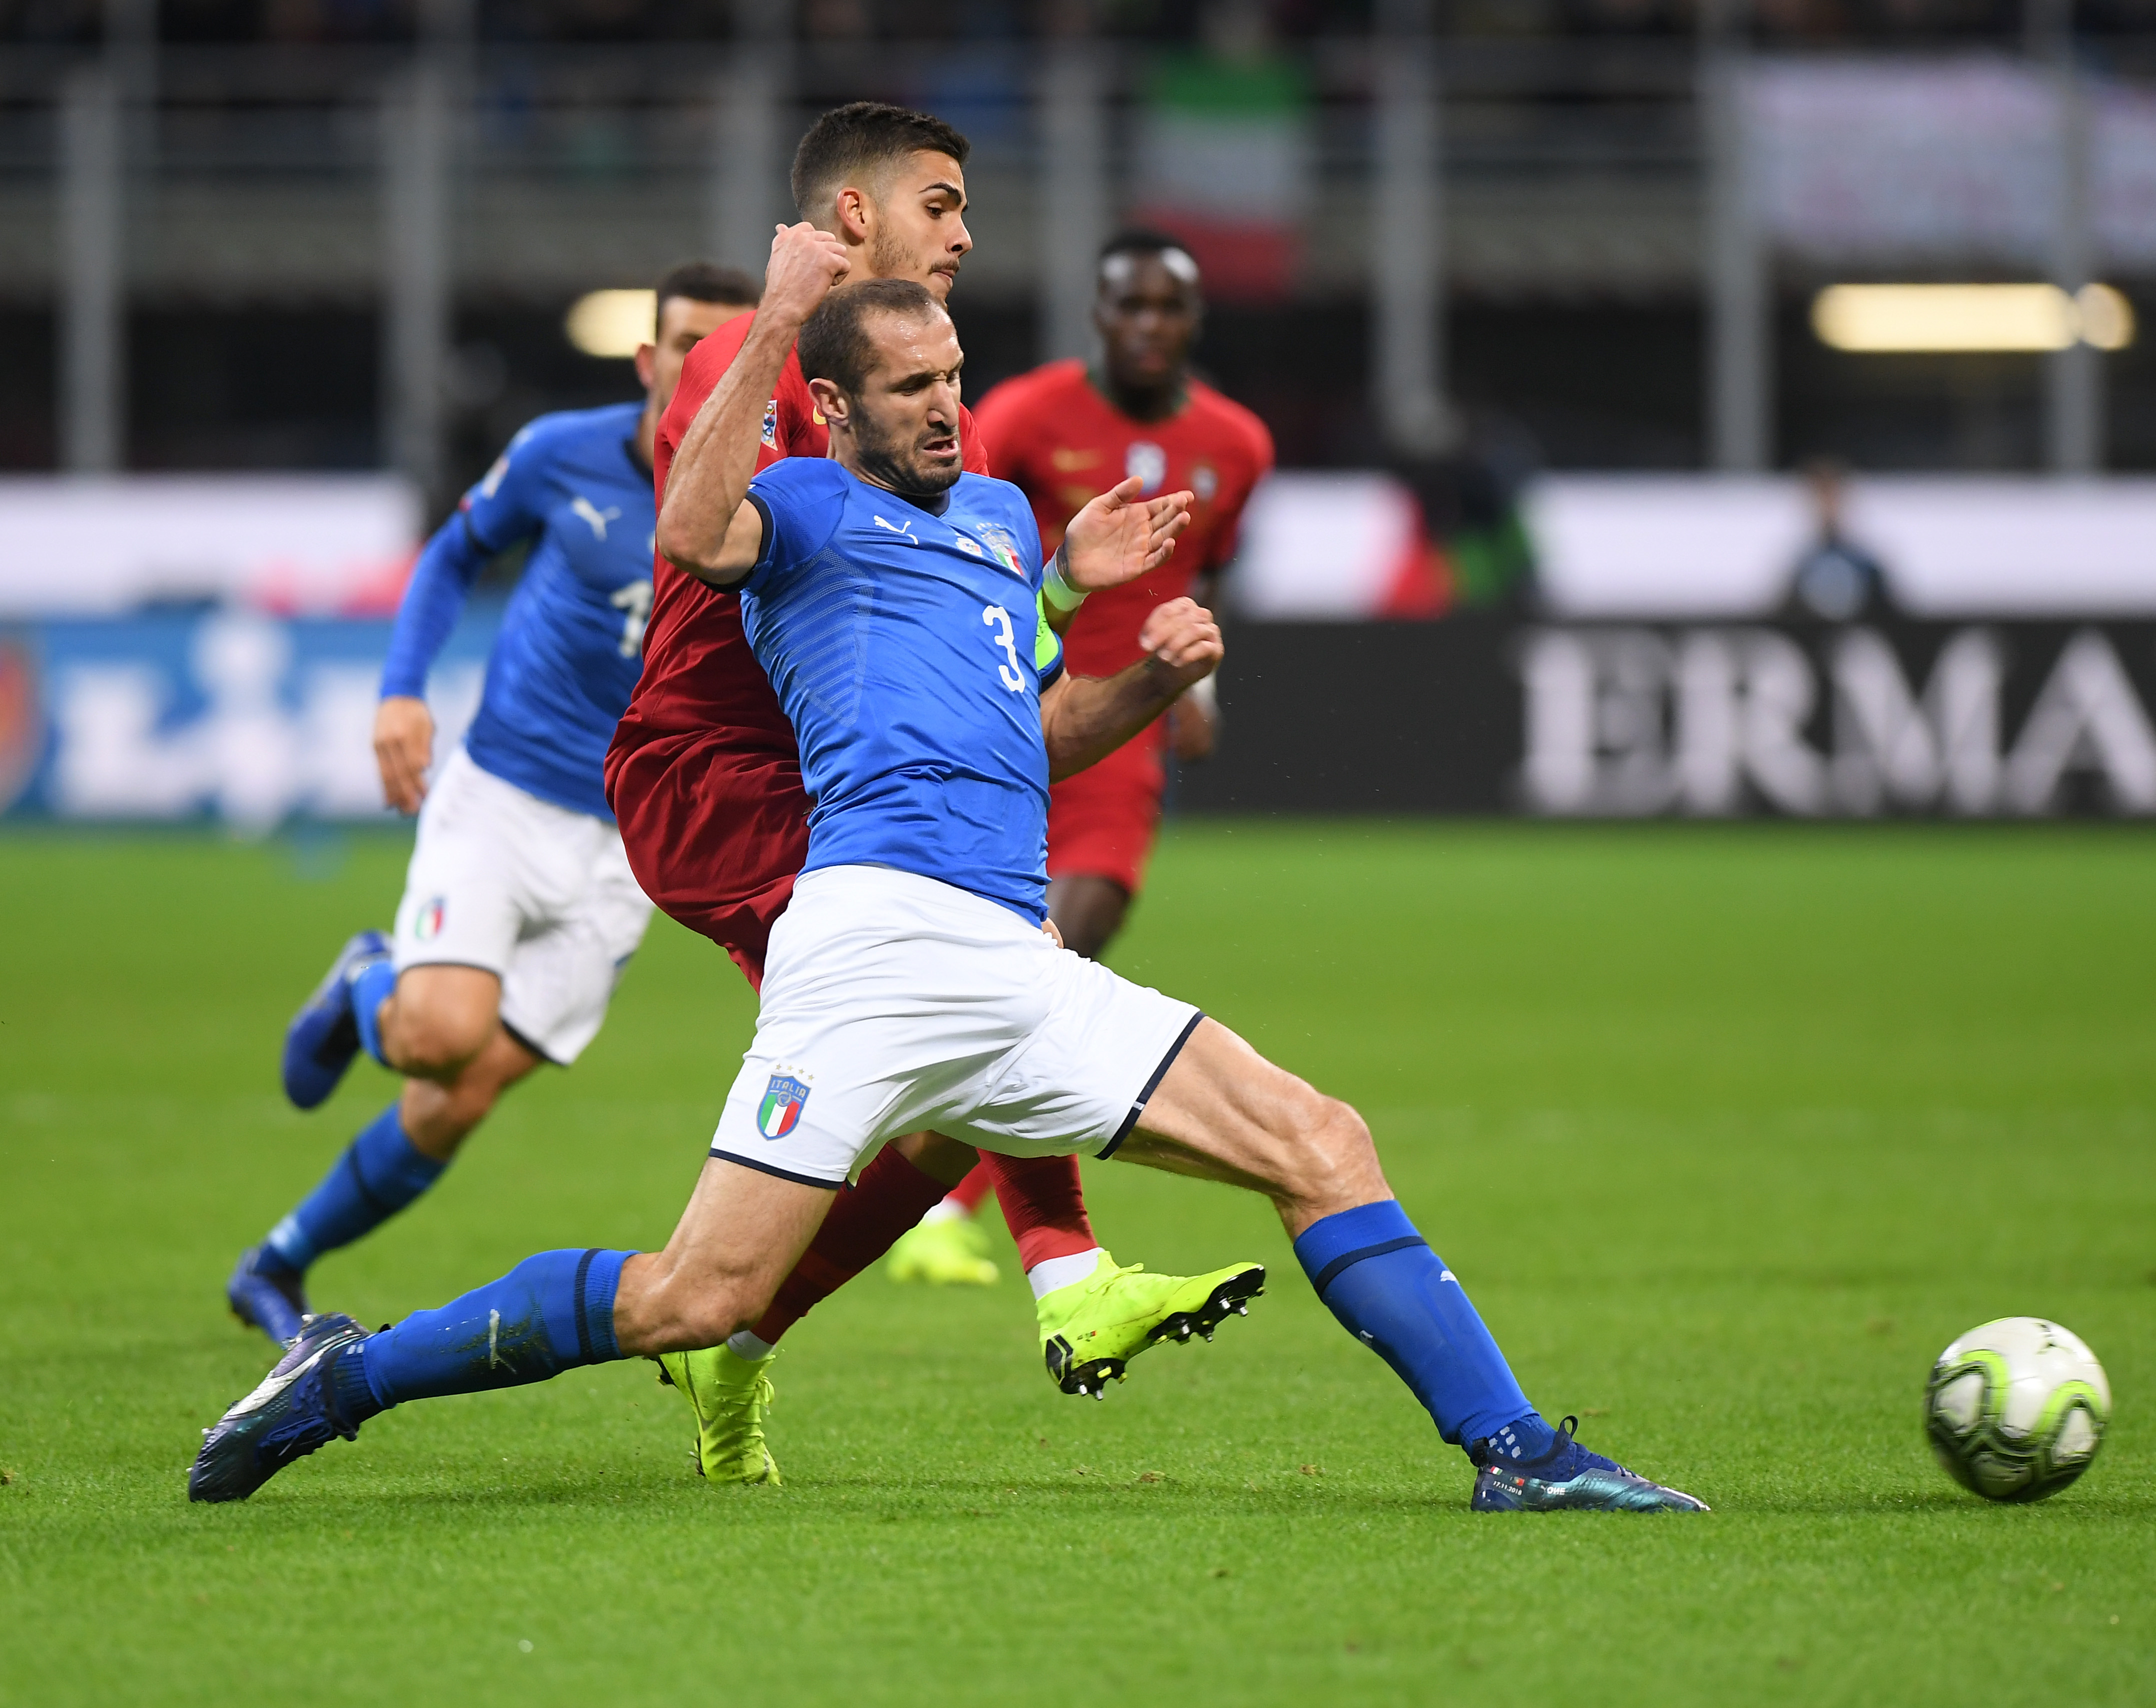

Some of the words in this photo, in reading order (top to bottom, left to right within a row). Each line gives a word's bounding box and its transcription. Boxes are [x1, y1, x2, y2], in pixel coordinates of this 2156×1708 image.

[982, 605, 1026, 693] 3
[1518, 632, 2156, 816] ERMA
[771, 1080, 806, 1098] ITALIA
[1493, 1480, 1522, 1496] 17.11.2018
